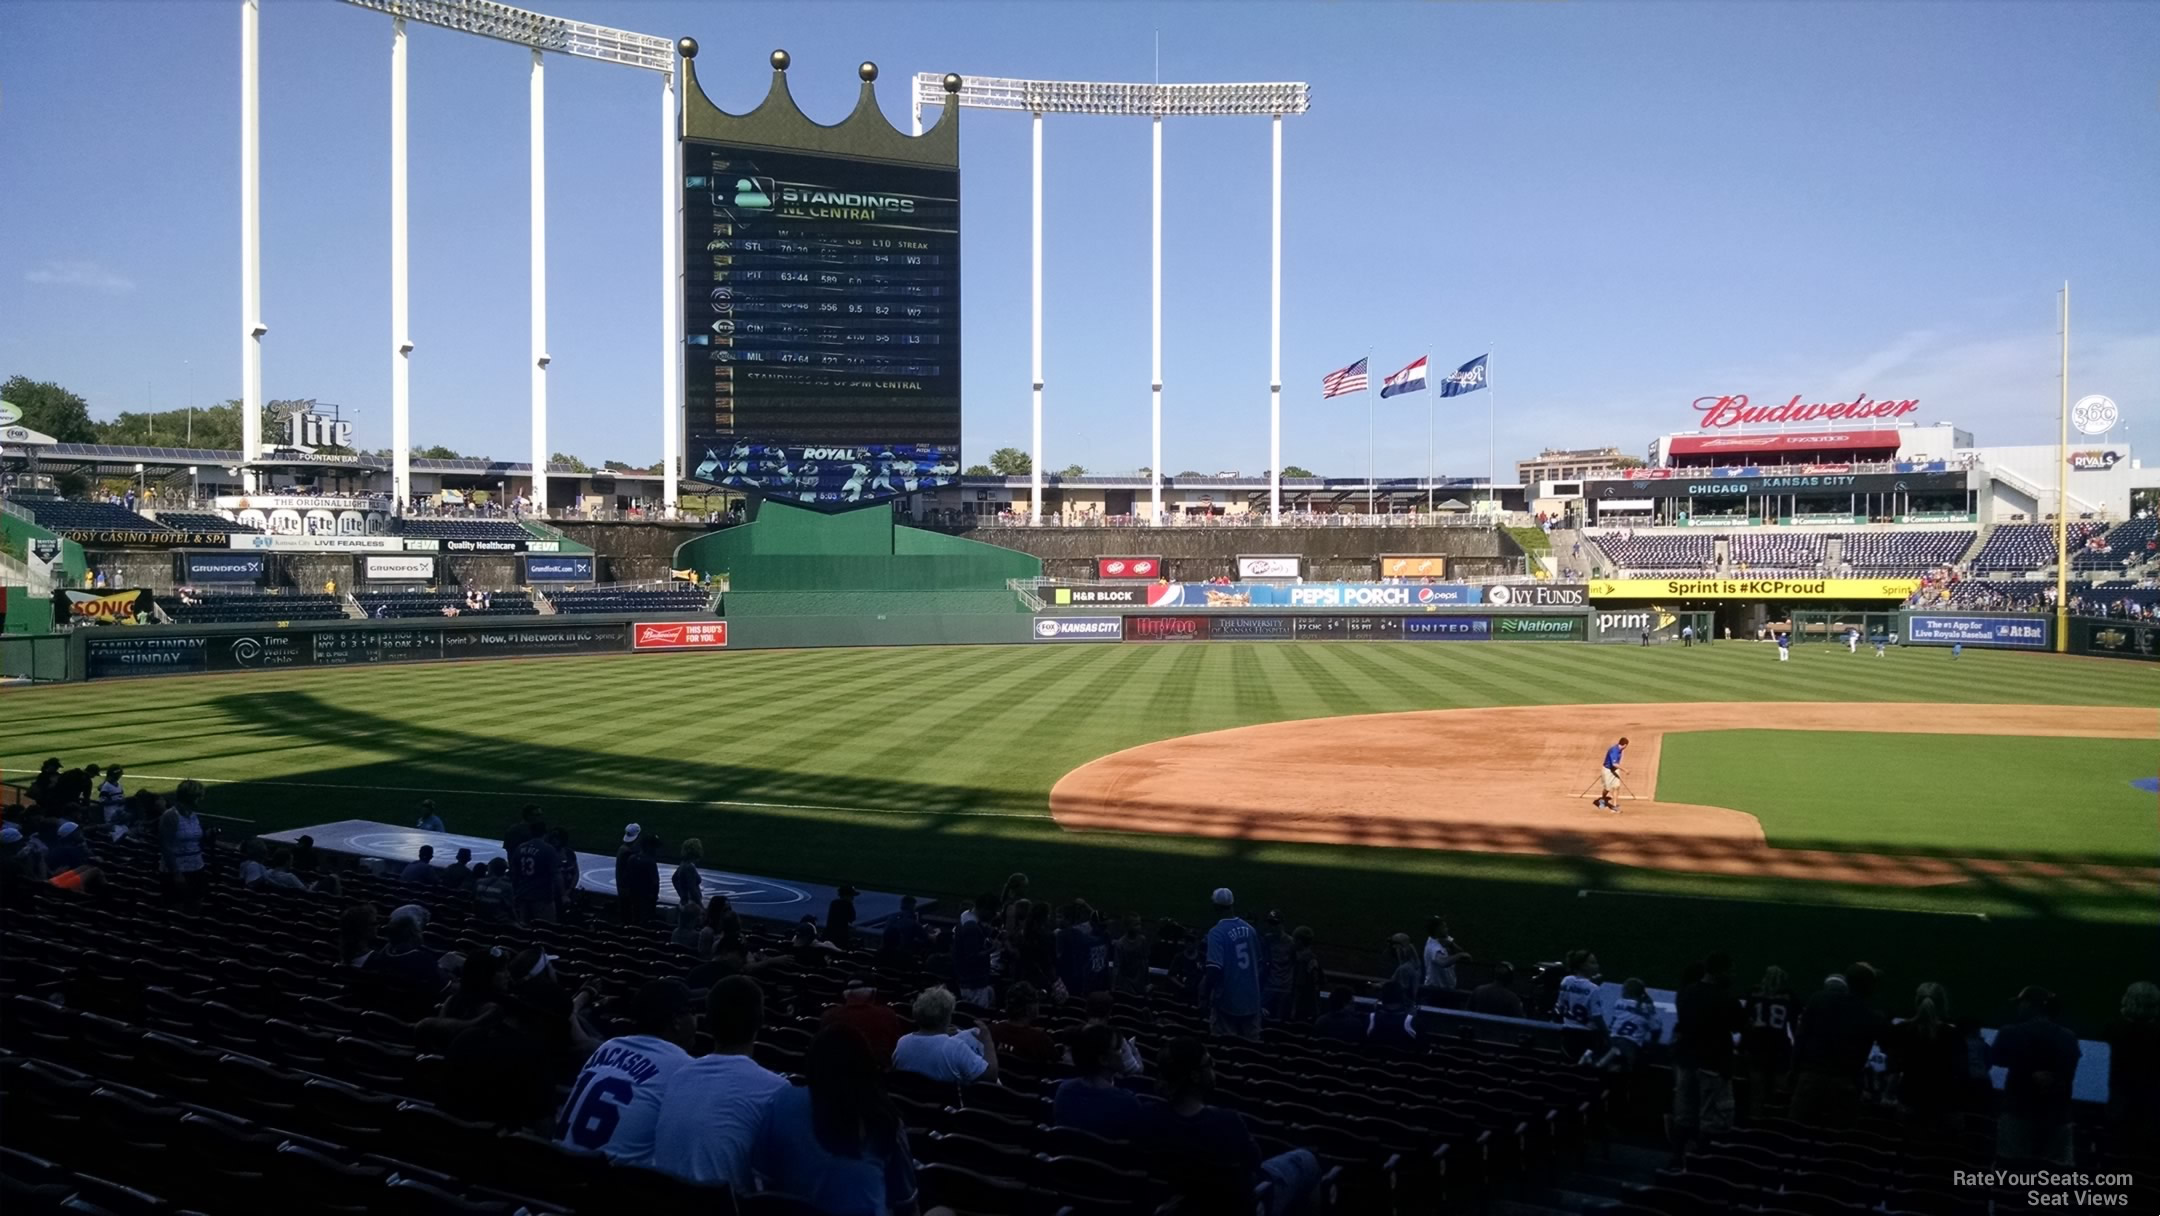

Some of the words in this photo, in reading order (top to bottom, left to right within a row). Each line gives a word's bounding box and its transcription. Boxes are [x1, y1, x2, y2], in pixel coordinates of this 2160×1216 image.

[783, 188, 915, 213] STANDINGS
[744, 241, 763, 251] STL
[872, 239, 891, 248] L10
[898, 240, 928, 250] STREAK
[906, 256, 921, 264] W3
[747, 271, 762, 279] PIT
[781, 272, 808, 281] 63-44
[848, 304, 862, 313] 9.5
[875, 306, 889, 315] 8-2
[907, 308, 921, 316] W2
[746, 324, 764, 333] CIN
[909, 335, 920, 343] L3
[747, 352, 764, 361] MIL
[781, 354, 809, 363] 47-64
[1693, 393, 1920, 429] Budweiser
[2075, 402, 2116, 426] 360
[287, 412, 353, 454] Lite
[300, 453, 340, 462] FOUNTAIN
[341, 455, 358, 463] BAR
[803, 447, 856, 461] ROYAL
[2075, 456, 2115, 467] RIVALS
[1802, 464, 1849, 473] Budweiser
[1688, 484, 1748, 494] CHICAGO
[1763, 476, 1819, 488] KANSAS
[1824, 476, 1855, 487] CITY
[273, 498, 295, 506] THE
[296, 499, 341, 508] ORIGINAL
[343, 500, 368, 509] LIGHT
[1695, 519, 1732, 527] Commerce
[1799, 517, 1836, 525] Commerce
[1837, 517, 1855, 525] Bank
[1910, 515, 1949, 523] Commerce
[1950, 515, 1969, 523] Bank
[341, 517, 362, 533] Lite
[100, 532, 147, 543] CASINO
[151, 533, 190, 544] HOTEL
[193, 534, 202, 544] &
[205, 534, 227, 544] SPA
[404, 539, 439, 550] TEVA
[447, 540, 475, 551] Quality
[476, 540, 516, 550] Healthcare
[525, 541, 559, 552] TEVA
[191, 564, 247, 572] GRUNDFOS
[1668, 580, 1719, 596] Sprint
[1722, 580, 1736, 594] is
[1740, 580, 1825, 595] #KCProud
[1882, 585, 1913, 596] Sprint
[1073, 591, 1095, 601] H&R
[1097, 591, 1132, 601] BLOCK
[1291, 588, 1342, 604] PEPSI
[1344, 588, 1409, 604] PORCH
[1434, 591, 1457, 600] pepsi
[1511, 587, 1535, 604] IVY
[1537, 587, 1583, 604] FUNDS
[73, 600, 135, 617] SONIC
[1061, 622, 1098, 633] KANSAS
[1219, 618, 1235, 627] THE
[1236, 618, 1284, 628] UNIVERSITY
[1410, 623, 1469, 633] UNITED
[1517, 620, 1573, 632] National
[1596, 611, 1649, 634] print
[1926, 621, 1942, 630] The
[1953, 622, 1971, 631] App
[1971, 621, 1983, 630] for
[685, 625, 701, 634] THIS
[702, 625, 723, 634] BUD'S
[1915, 629, 1932, 638] Live
[1933, 630, 1960, 640] Royals
[1961, 630, 1993, 640] Baseball
[2010, 626, 2023, 637] At
[2024, 626, 2042, 638] Bat
[264, 636, 289, 645] Time
[318, 633, 334, 641] TOR
[446, 637, 467, 646] Sprint
[481, 633, 507, 645] Now,
[520, 631, 564, 643] Network
[566, 631, 576, 641] in
[577, 631, 592, 641] KC
[685, 634, 699, 642] FOR
[700, 633, 716, 642] YOU.
[394, 640, 412, 648] OAK
[416, 640, 422, 648] 2
[121, 652, 180, 664] SUNDAY
[264, 657, 292, 665] Cable
[520, 856, 536, 877] 13
[1227, 926, 1249, 942] BRETT
[1235, 942, 1249, 970] 5
[1752, 1002, 1788, 1029] 18
[585, 1047, 660, 1085] JACKSON
[554, 1070, 633, 1150] 16
